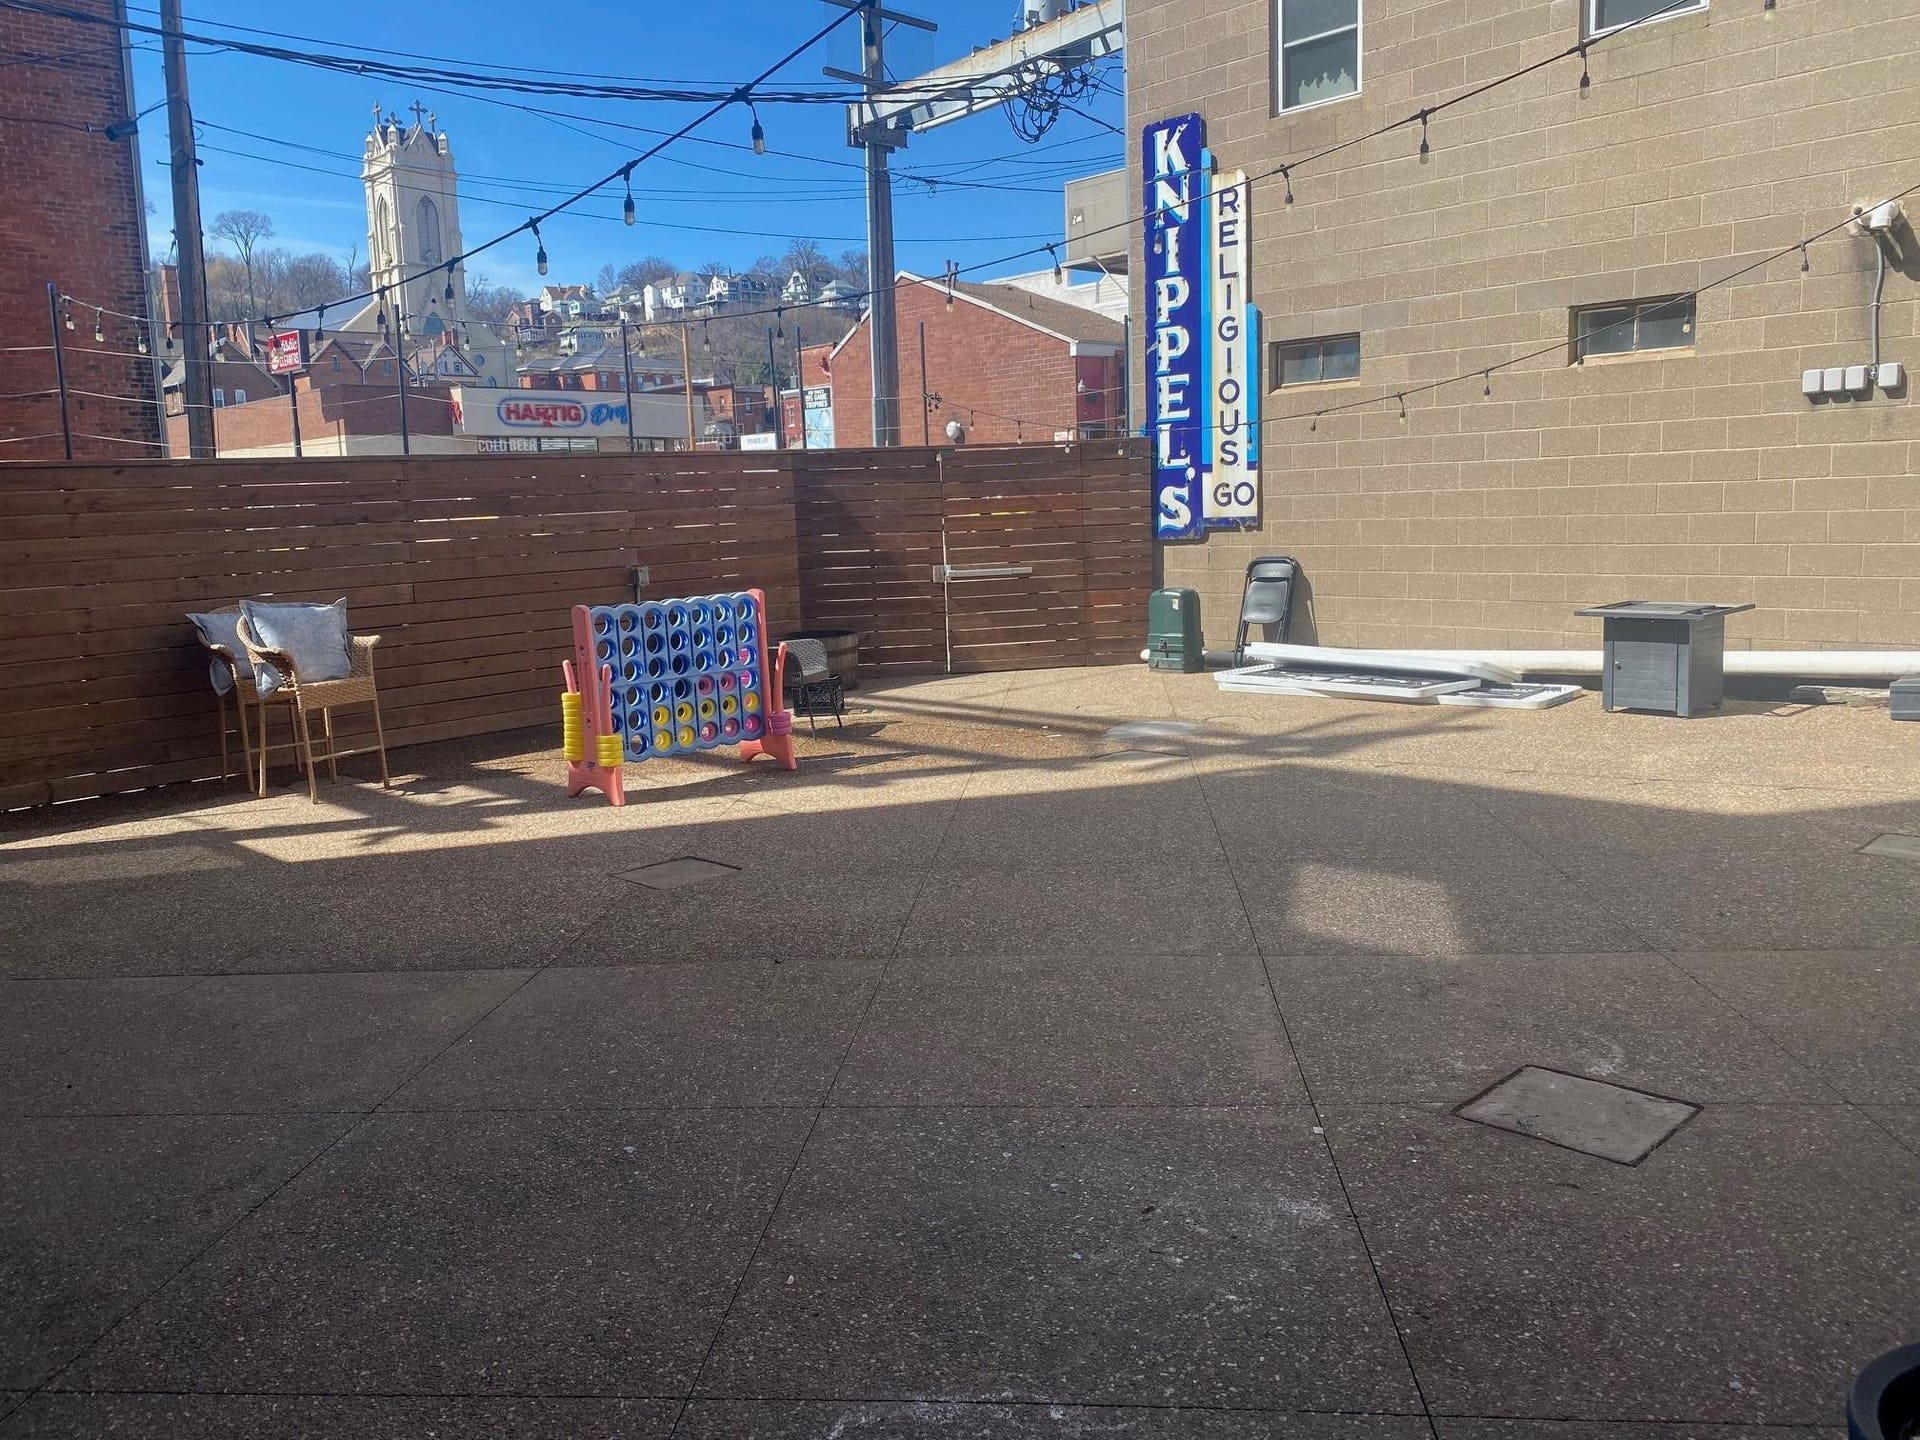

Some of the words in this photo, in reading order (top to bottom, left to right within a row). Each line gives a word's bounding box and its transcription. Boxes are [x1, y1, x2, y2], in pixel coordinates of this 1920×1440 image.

[1153, 121, 1196, 536] KNIPPEL'S
[1217, 187, 1241, 467] RELIGIOUS
[505, 403, 582, 428] HARTIG
[479, 439, 507, 452] COLD
[508, 437, 538, 452] BEER
[1213, 481, 1255, 507] GO
